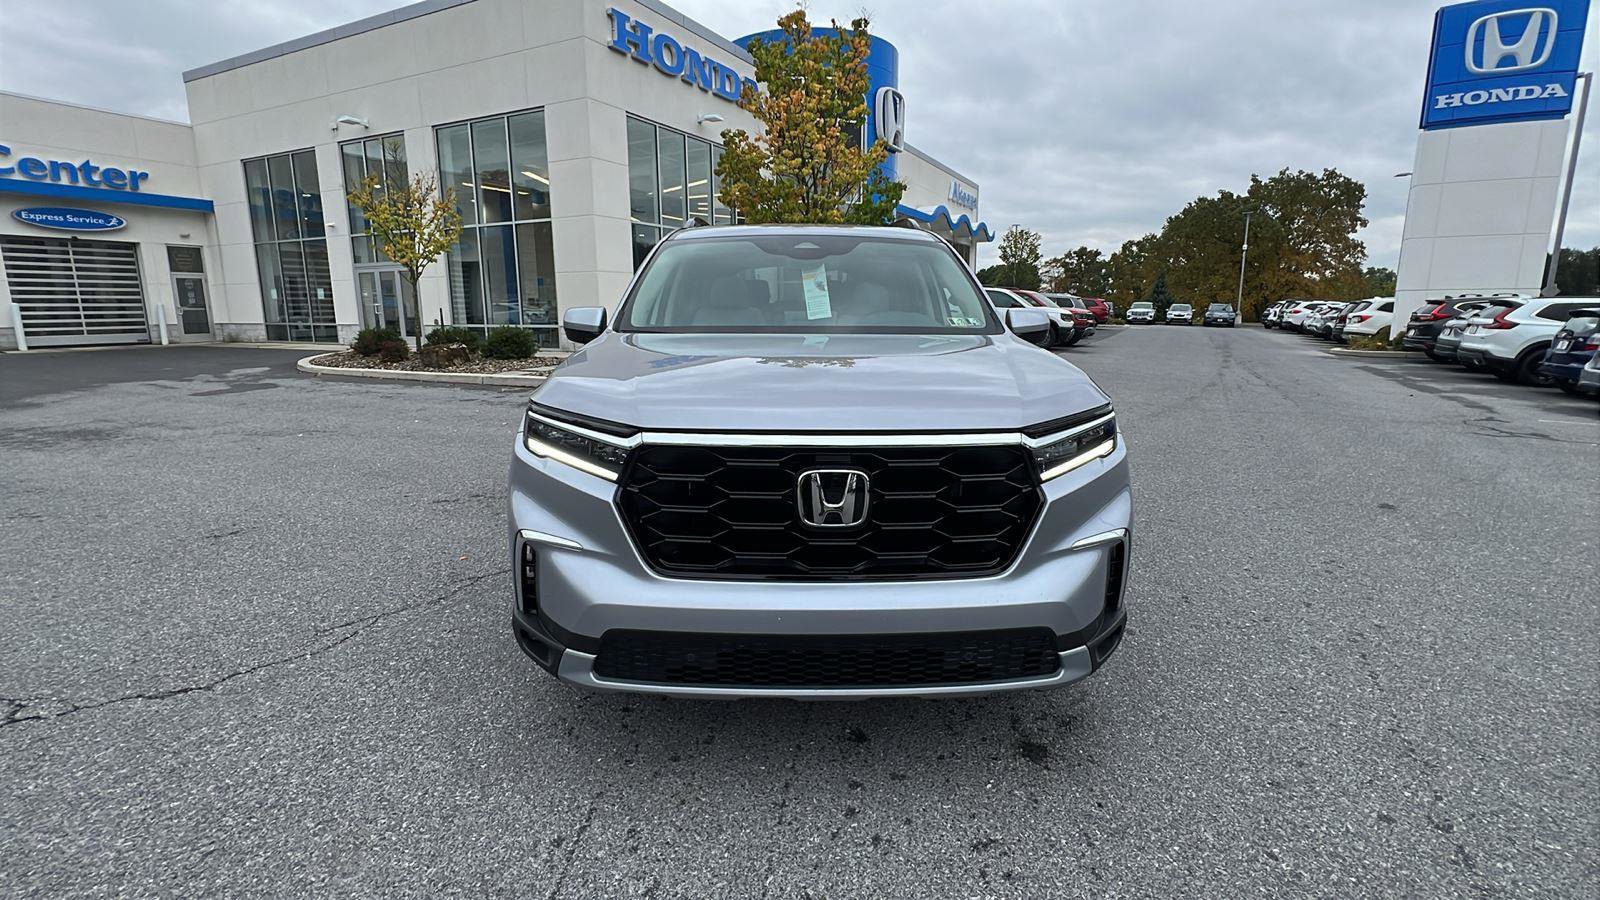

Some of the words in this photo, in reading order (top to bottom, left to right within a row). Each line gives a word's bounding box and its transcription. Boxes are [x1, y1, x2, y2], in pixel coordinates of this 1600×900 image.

[1434, 83, 1568, 109] HONDA
[21, 211, 64, 222] Express
[66, 214, 105, 225] Service
